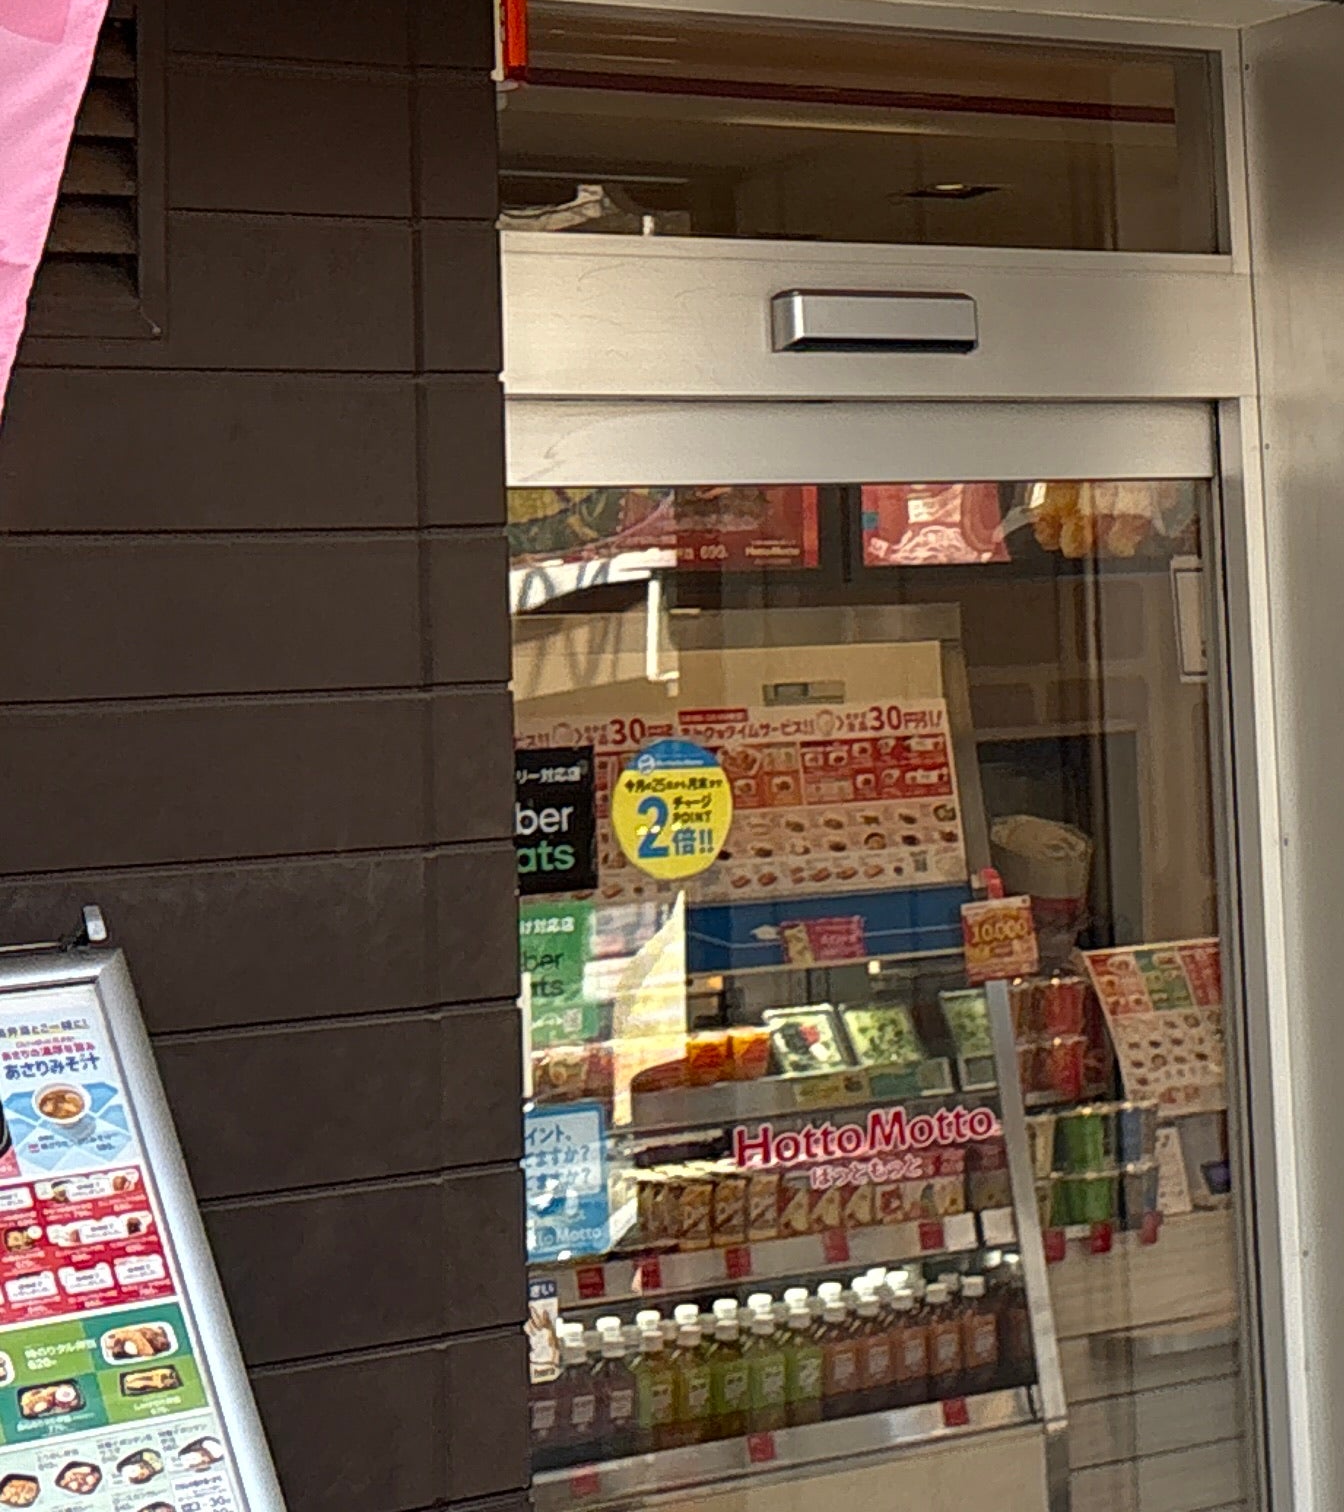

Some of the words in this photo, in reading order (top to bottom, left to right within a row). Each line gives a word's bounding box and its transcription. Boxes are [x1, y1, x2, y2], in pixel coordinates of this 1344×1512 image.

[637, 795, 669, 860] 2
[3, 1052, 101, 1080] あさりみそ汁
[735, 1105, 995, 1167] HottoMotto
[810, 1153, 923, 1189] ほっともっと
